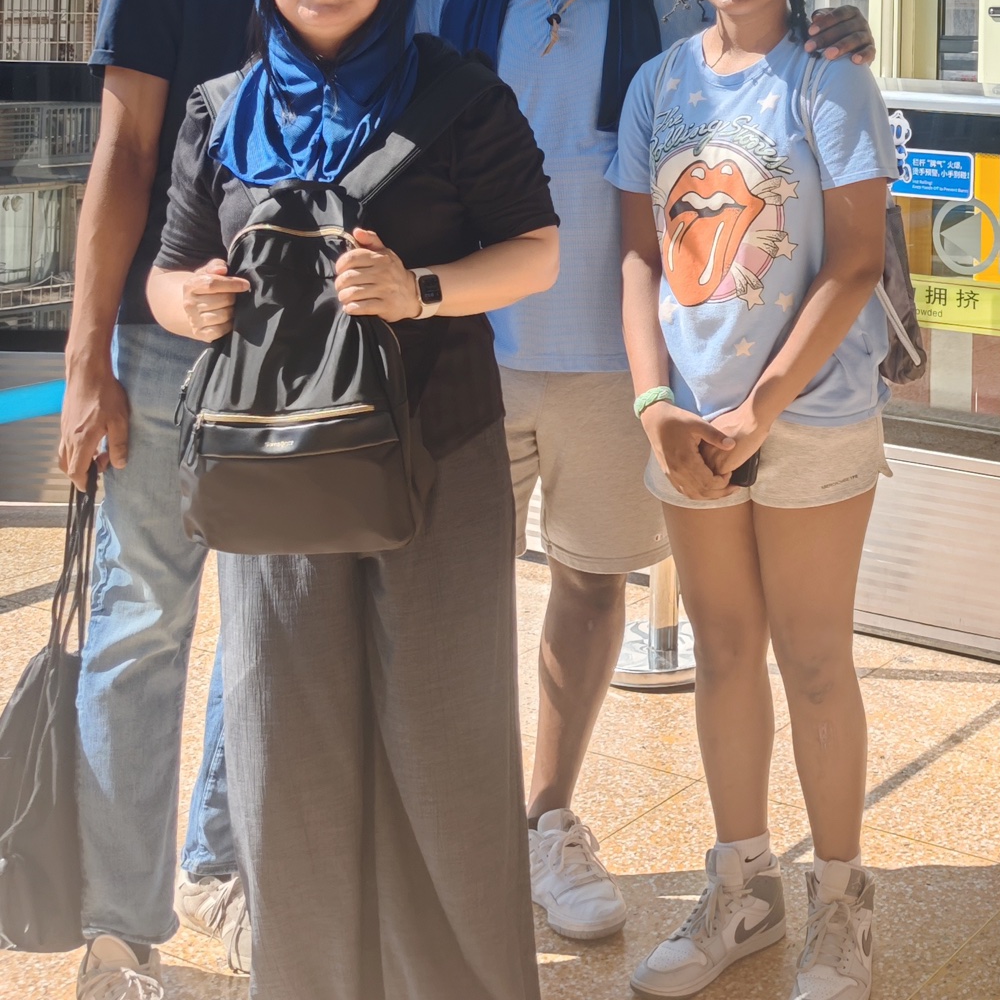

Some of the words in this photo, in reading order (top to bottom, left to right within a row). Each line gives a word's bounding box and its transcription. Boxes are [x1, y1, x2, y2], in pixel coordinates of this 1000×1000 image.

[654, 105, 684, 134] The
[914, 286, 980, 310] 拥挤
[916, 308, 943, 318] owded
